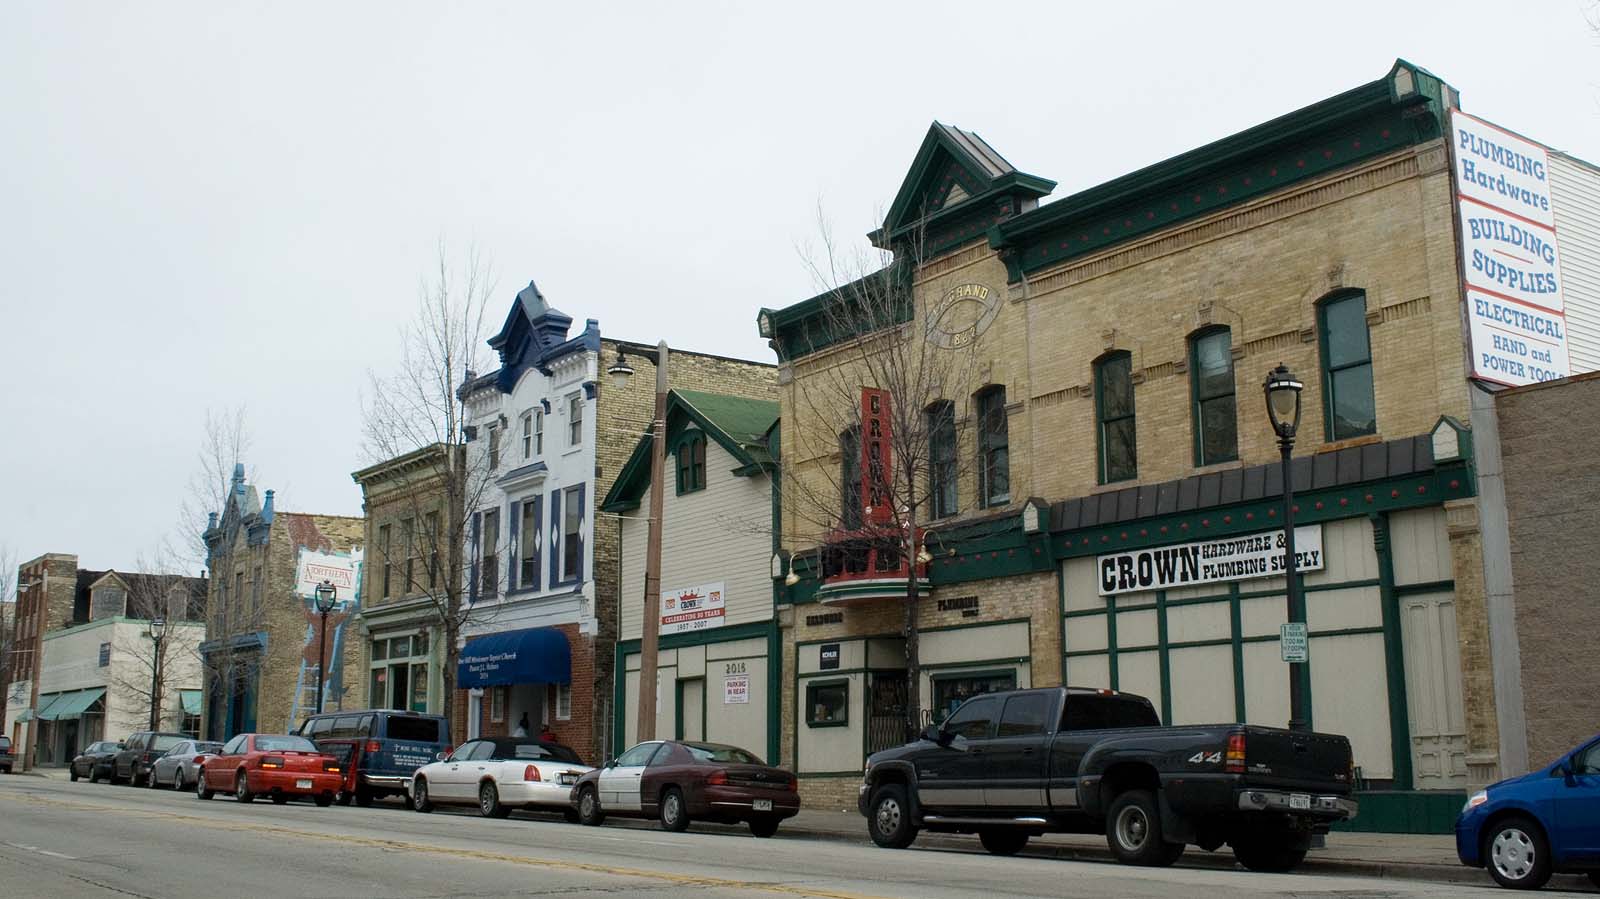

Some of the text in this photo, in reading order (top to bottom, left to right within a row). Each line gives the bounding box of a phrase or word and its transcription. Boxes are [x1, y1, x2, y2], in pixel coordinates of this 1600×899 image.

[1459, 129, 1546, 182] PLUMBING
[1461, 158, 1549, 211] Hardware
[1468, 218, 1555, 266] BUILDING
[1472, 248, 1557, 294] SUPPLIES
[1474, 299, 1563, 340] ELECTRICAL
[1482, 353, 1526, 378] POWER
[1493, 334, 1552, 363] HAND and
[1102, 533, 1287, 592] CROWN HARDWARE &
[1203, 550, 1319, 580] PLUMBING SUPLY
[694, 620, 708, 629] 2007
